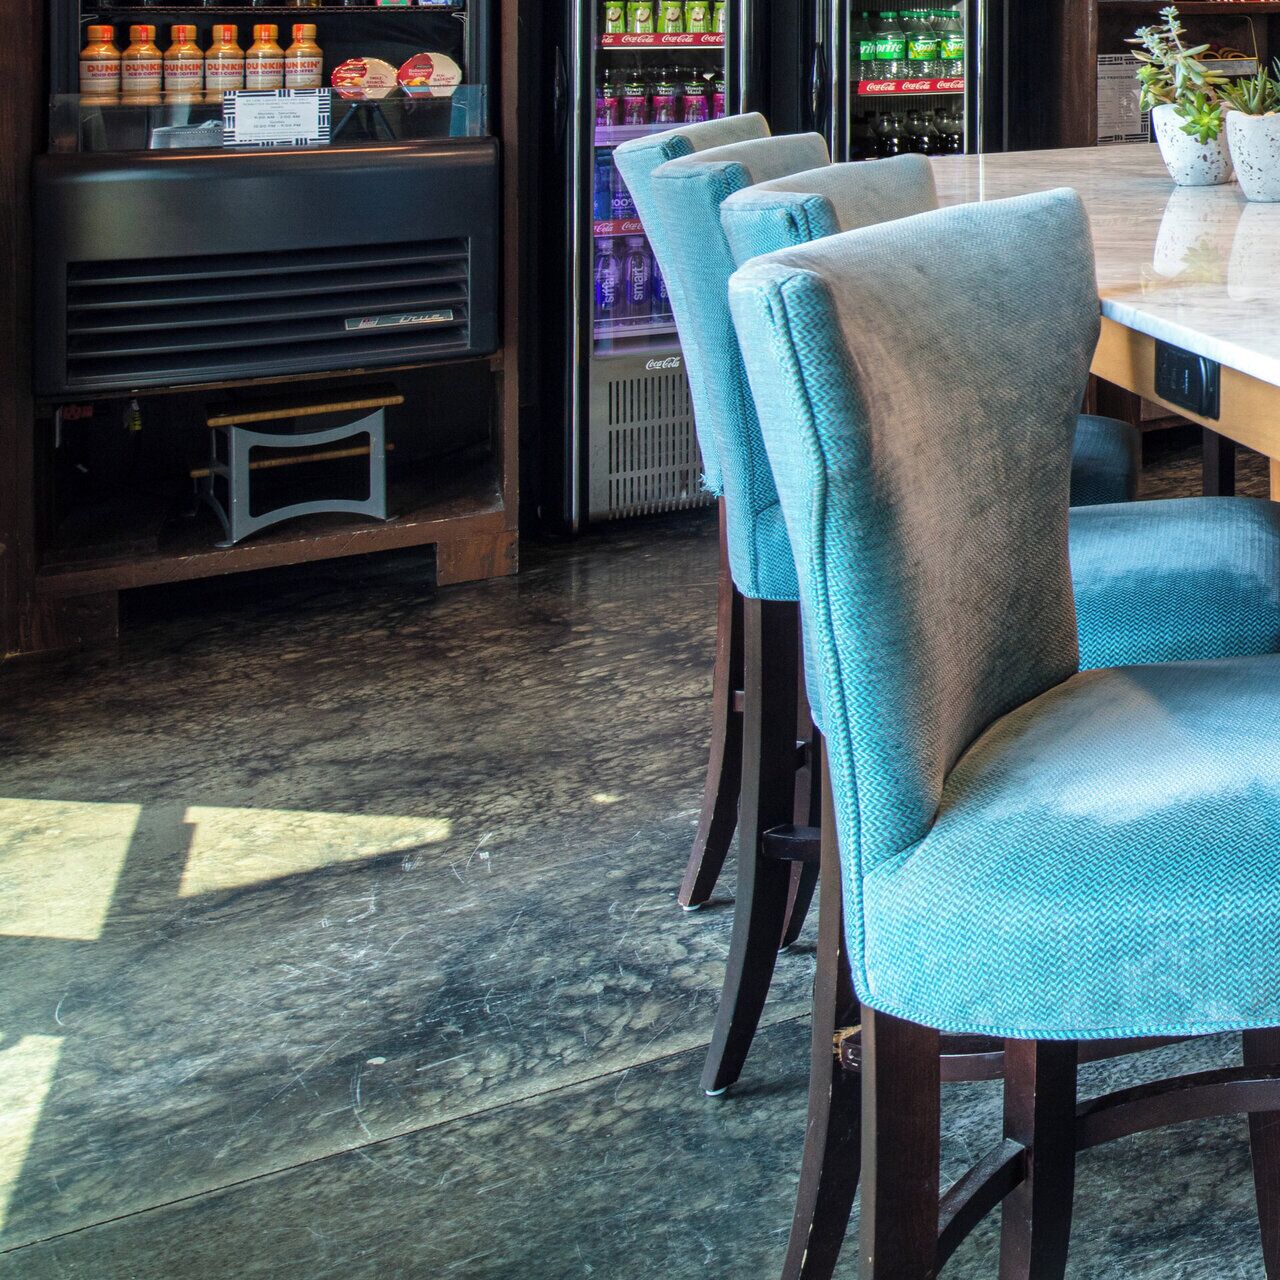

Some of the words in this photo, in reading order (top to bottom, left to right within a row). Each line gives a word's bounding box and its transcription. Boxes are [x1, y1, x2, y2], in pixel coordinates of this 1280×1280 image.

[621, 34, 655, 43] Coca-Cola
[661, 34, 695, 43] Coca-Cola
[948, 40, 965, 52] Spri
[88, 64, 121, 73] DUNK
[125, 63, 161, 73] DUNKI
[866, 82, 897, 92] Coca-Cola
[901, 80, 932, 91] Coca-Cola
[632, 260, 644, 301] smart
[645, 356, 682, 371] Coca-Cola
